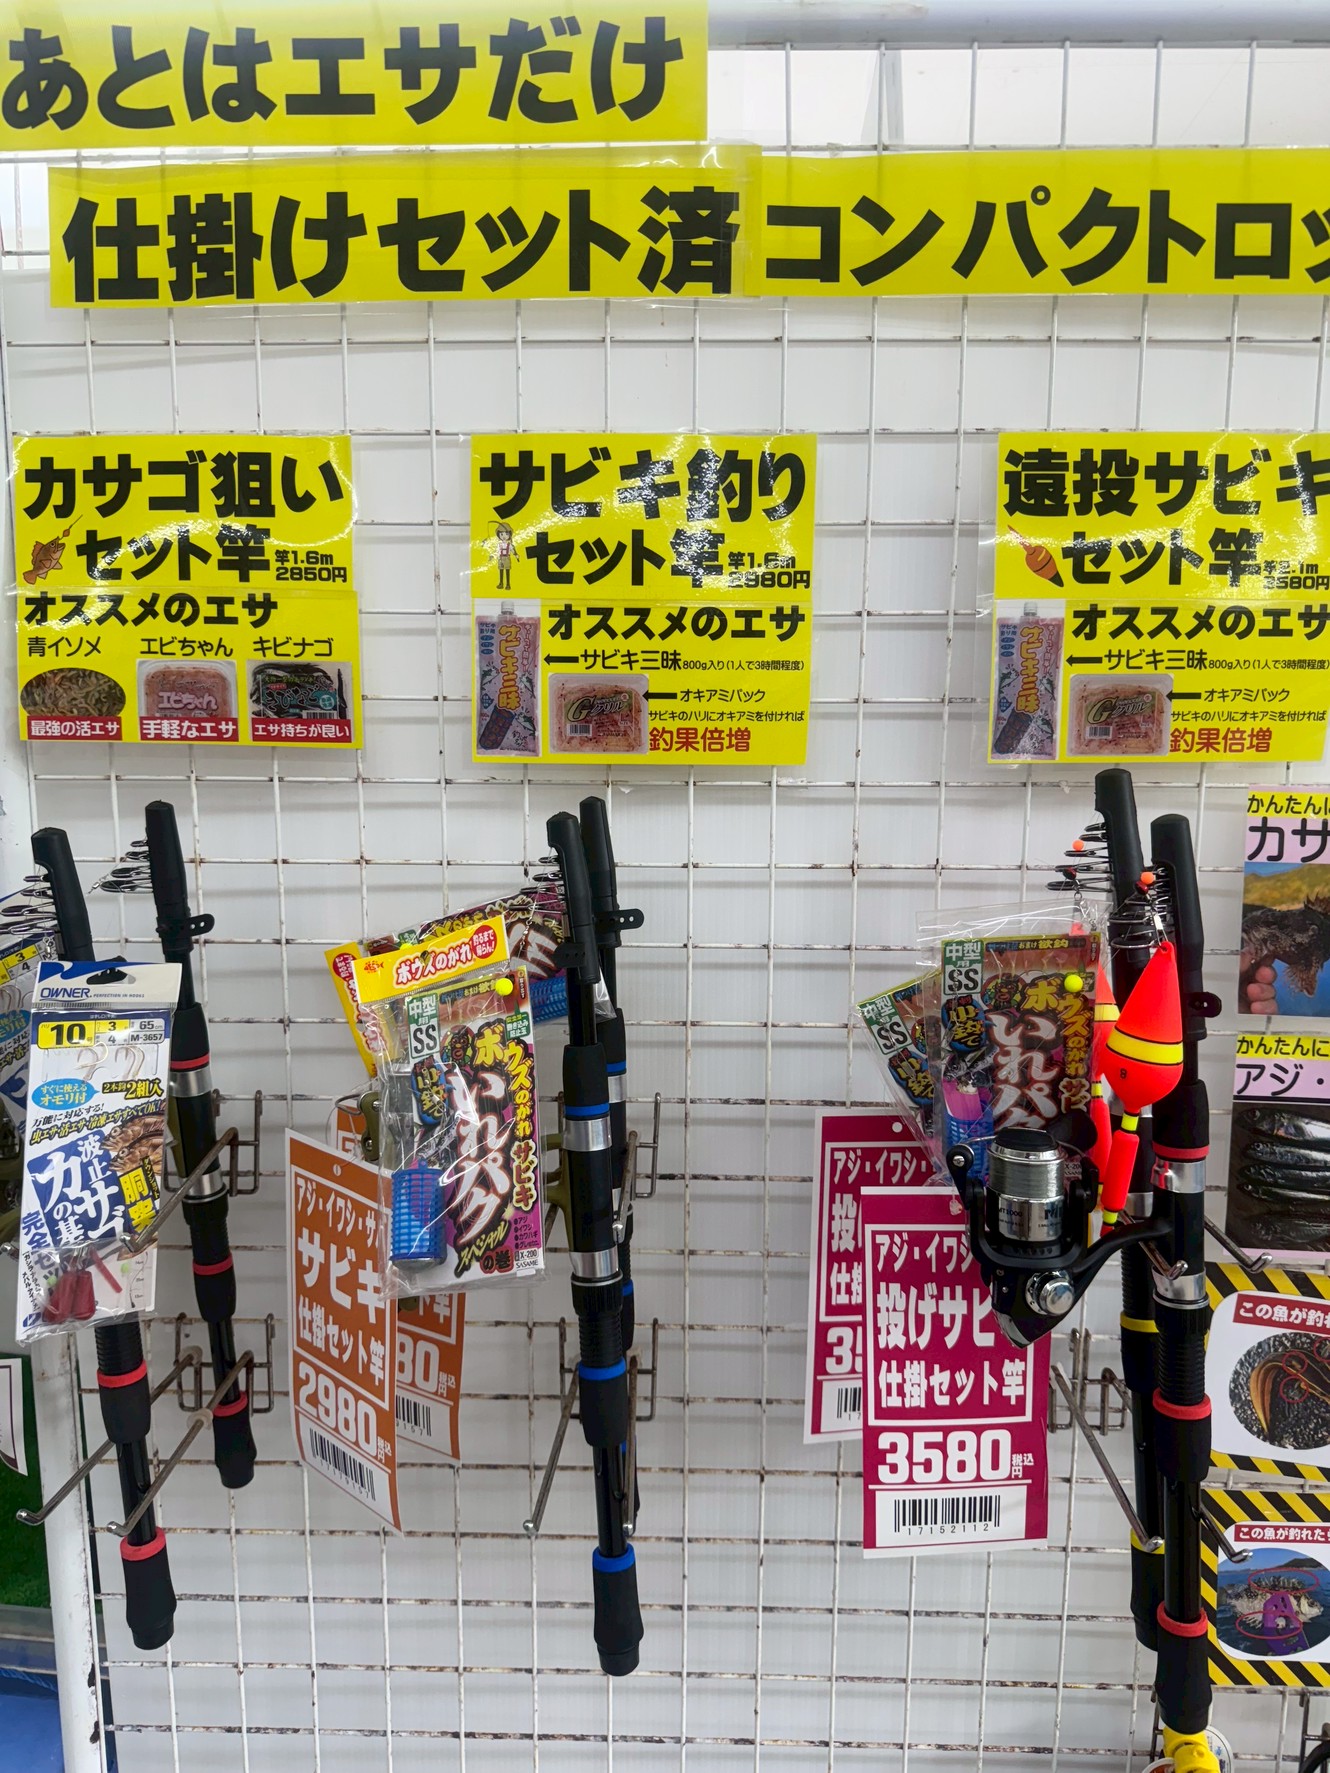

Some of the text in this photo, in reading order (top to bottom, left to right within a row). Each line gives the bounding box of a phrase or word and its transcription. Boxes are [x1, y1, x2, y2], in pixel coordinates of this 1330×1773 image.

[1, 15, 685, 131] あとはエサだけ
[62, 186, 741, 303] 仕掛けセット済
[23, 450, 345, 520] カサゴ狙い
[480, 447, 806, 522] サビキ釣り
[1003, 448, 1330, 518] 遠投サビキ
[76, 523, 271, 583] セット竿
[275, 550, 334, 566] 竿1.6m
[525, 528, 725, 589] セット竿
[1062, 528, 1264, 588] セット竿
[275, 567, 348, 583] 2850円
[728, 570, 811, 589] 2980円
[1263, 576, 1330, 590] 3580円
[24, 591, 279, 629] オススメのエサ
[548, 603, 806, 642] オススメのエサ
[1071, 603, 1330, 640] オススメのエサ
[27, 636, 102, 658] 青イソメ
[140, 637, 234, 658] エビちゃん
[253, 637, 335, 658] キビナゴ
[680, 689, 766, 704] オキアミパック
[1204, 688, 1290, 703] オキアミパック
[648, 710, 805, 723] サビキのハリにオキアミを付ければ
[1171, 710, 1327, 723] サビキのハリにオキアミを付ければ
[30, 719, 120, 738] 最強の活エサ
[143, 719, 237, 740] 手軽なエサ
[254, 722, 350, 739] エサ持ちが良い
[649, 727, 752, 753] 釣果倍増
[1169, 728, 1273, 754] 釣果倍増
[945, 941, 982, 962] 中型
[947, 969, 980, 992] SS
[409, 996, 437, 1017] 中型
[51, 1023, 86, 1045] 10
[108, 1021, 116, 1031] 3
[876, 1022, 908, 1051] SS
[108, 1034, 116, 1044] 4
[130, 1033, 163, 1042] M-3657
[412, 1024, 438, 1053] SS
[1236, 1036, 1330, 1057] かんたんに
[1119, 1068, 1127, 1079] 8
[41, 1092, 88, 1106] オモリ付
[514, 1142, 537, 1209] サビキ
[831, 1192, 862, 1253] 投
[298, 1227, 386, 1324] サビキ
[299, 1295, 385, 1386] 仕掛セット竿
[825, 1326, 862, 1374] 3
[879, 1359, 1026, 1409] 仕掛セット竿
[299, 1361, 377, 1457] 2980
[878, 1429, 1012, 1484] 3580
[907, 1523, 990, 1536] 17152112
